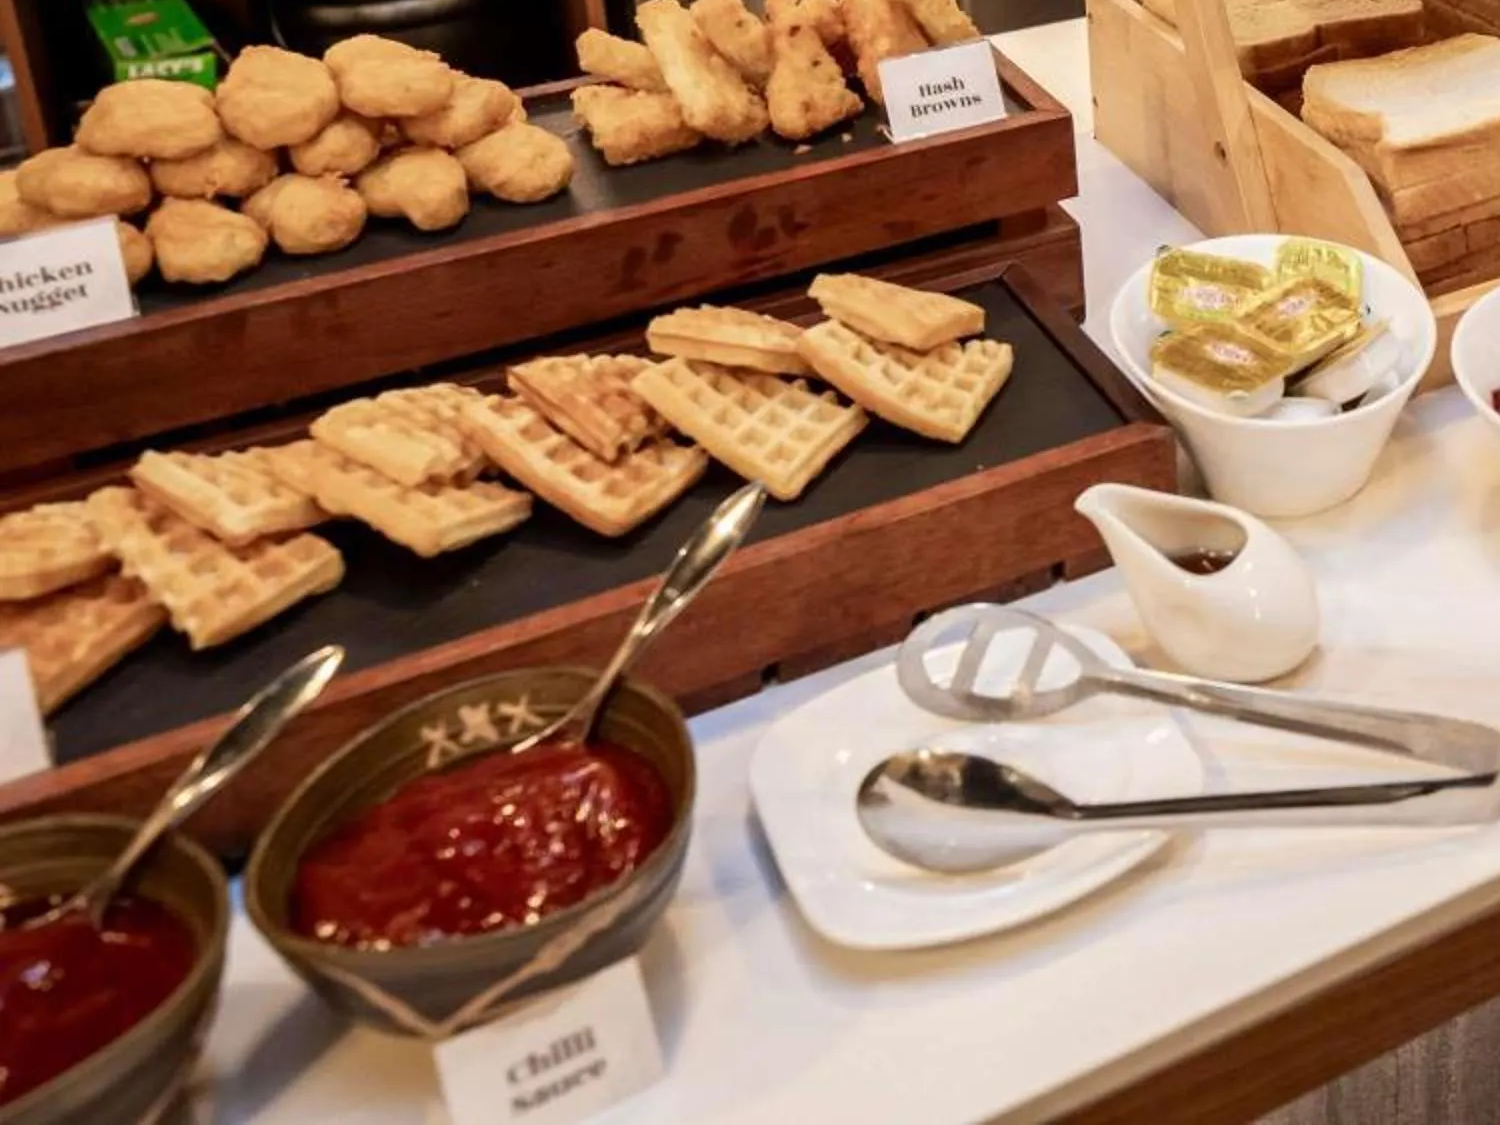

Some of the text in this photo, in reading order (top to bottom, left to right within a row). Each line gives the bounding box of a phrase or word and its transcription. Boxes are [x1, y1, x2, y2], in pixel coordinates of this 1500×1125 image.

[919, 76, 965, 98] Hash
[910, 95, 982, 118] Browns
[0, 261, 94, 294] hicken
[506, 1026, 596, 1085] Chilli
[510, 1058, 608, 1115] Sauce
